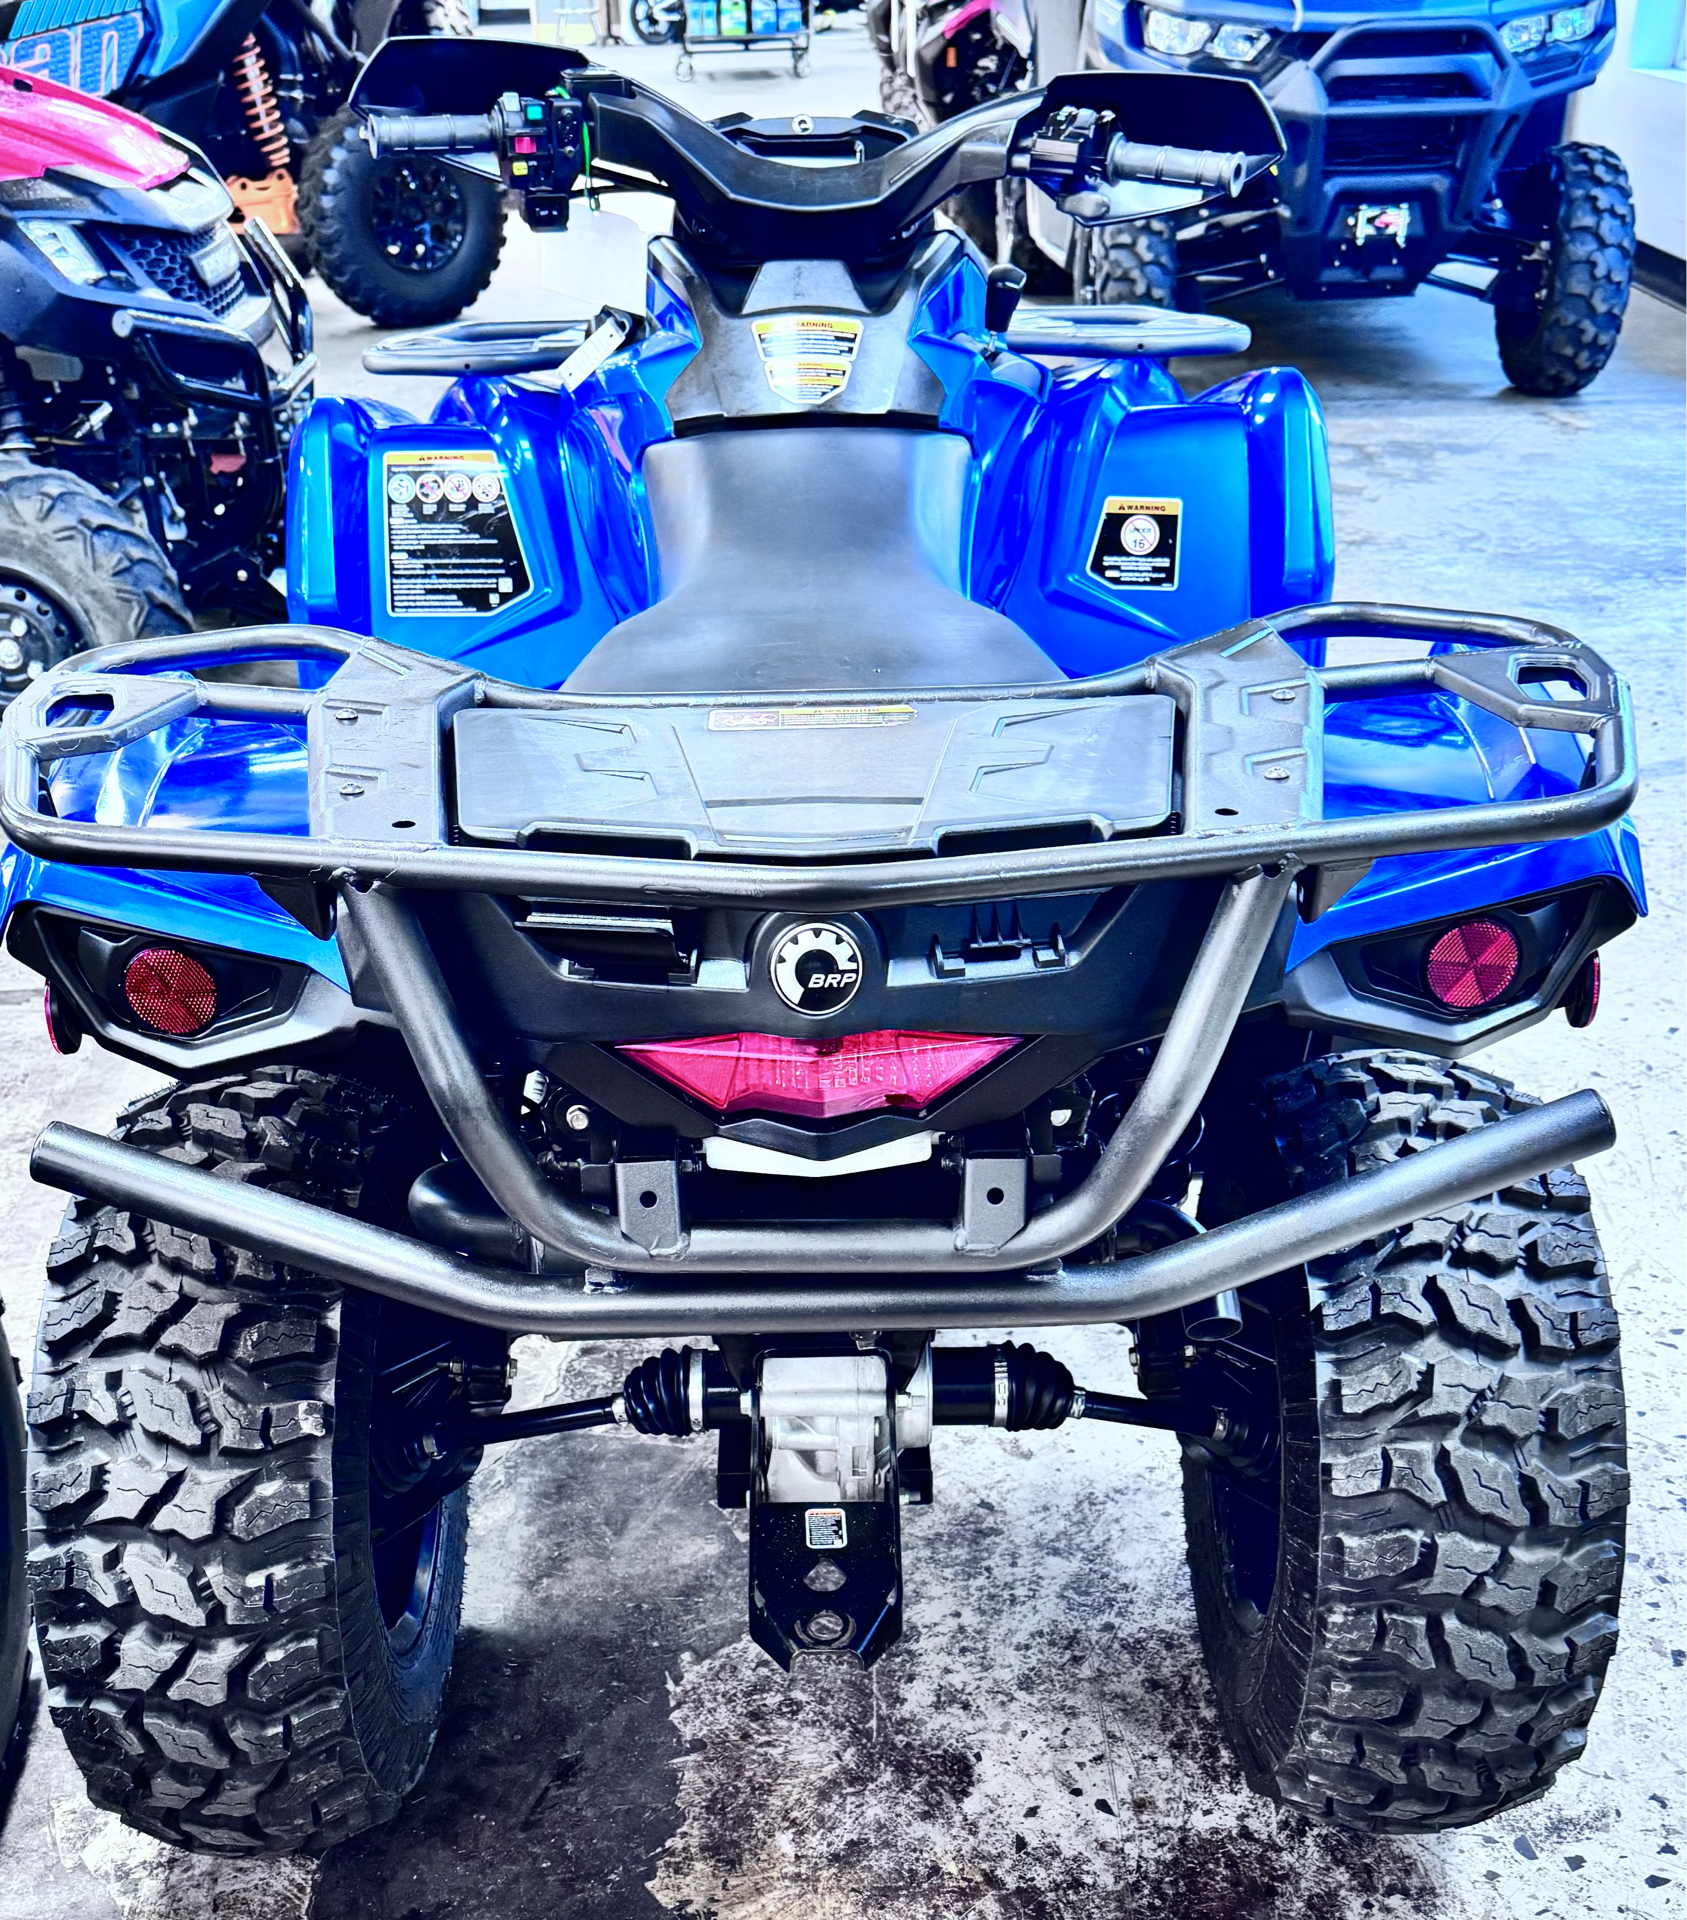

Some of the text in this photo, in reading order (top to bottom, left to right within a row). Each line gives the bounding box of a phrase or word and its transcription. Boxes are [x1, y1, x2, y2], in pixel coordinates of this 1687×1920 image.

[0, 12, 144, 97] an
[1126, 504, 1166, 512] WARNING
[1133, 539, 1145, 549] 16
[807, 972, 857, 988] BRP
